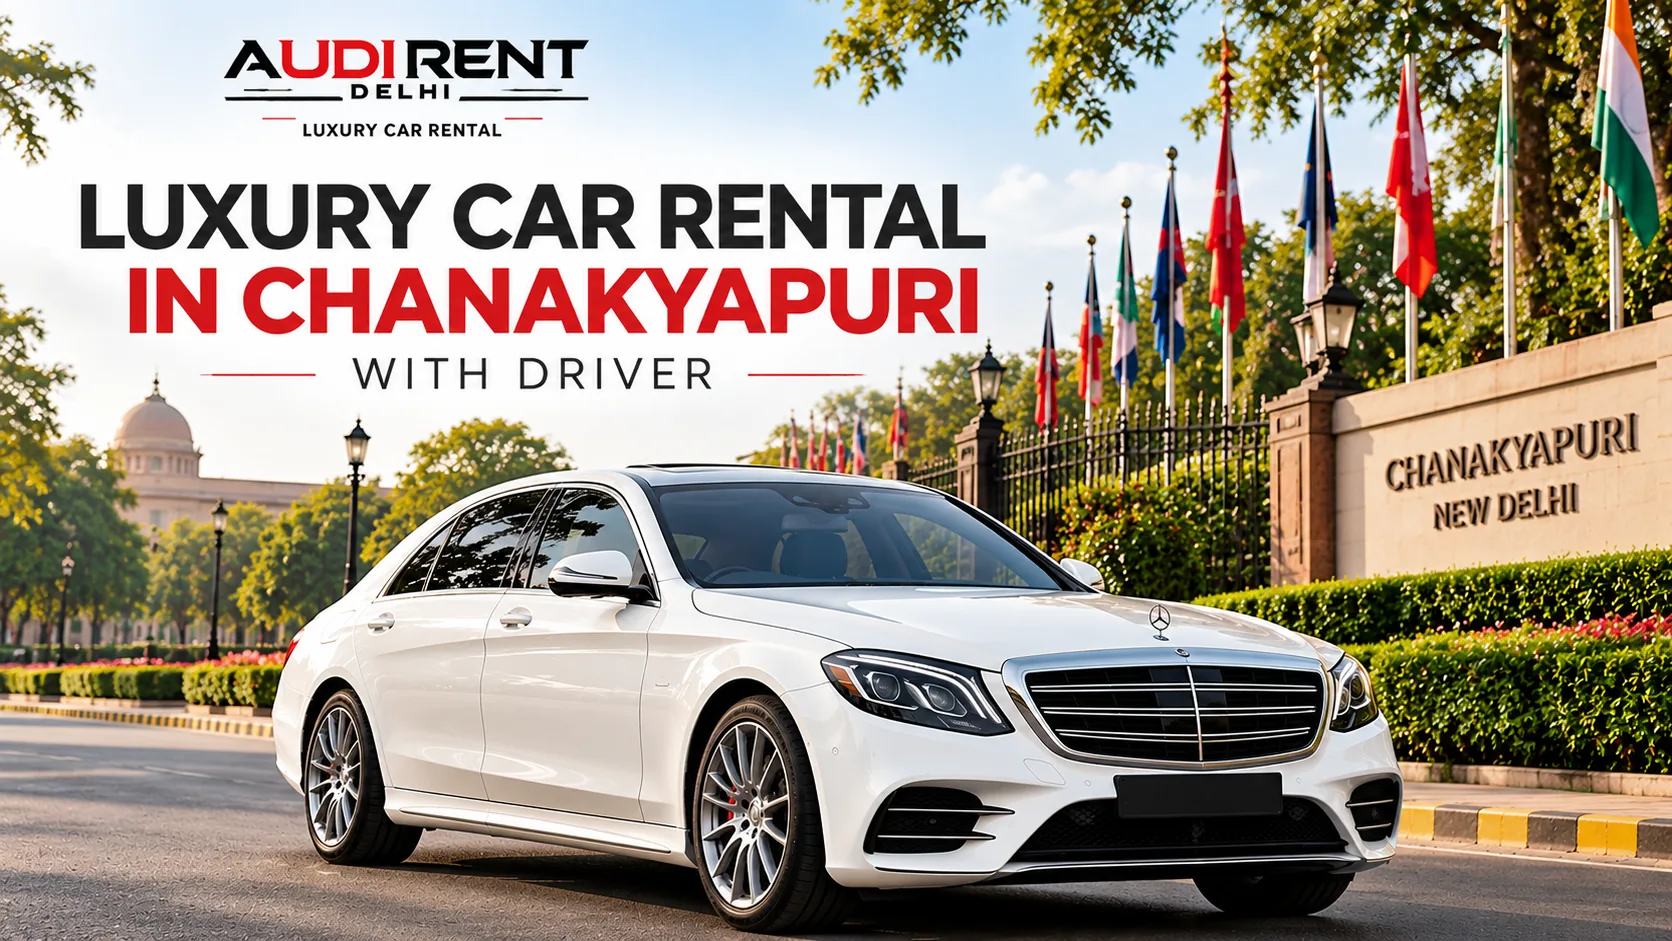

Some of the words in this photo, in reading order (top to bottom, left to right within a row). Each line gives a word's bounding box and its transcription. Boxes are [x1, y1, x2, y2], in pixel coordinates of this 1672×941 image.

[1385, 412, 1640, 492] CHANAKYAPURI
[1433, 496, 1492, 531] NEW
[1497, 482, 1579, 522] DELHI
